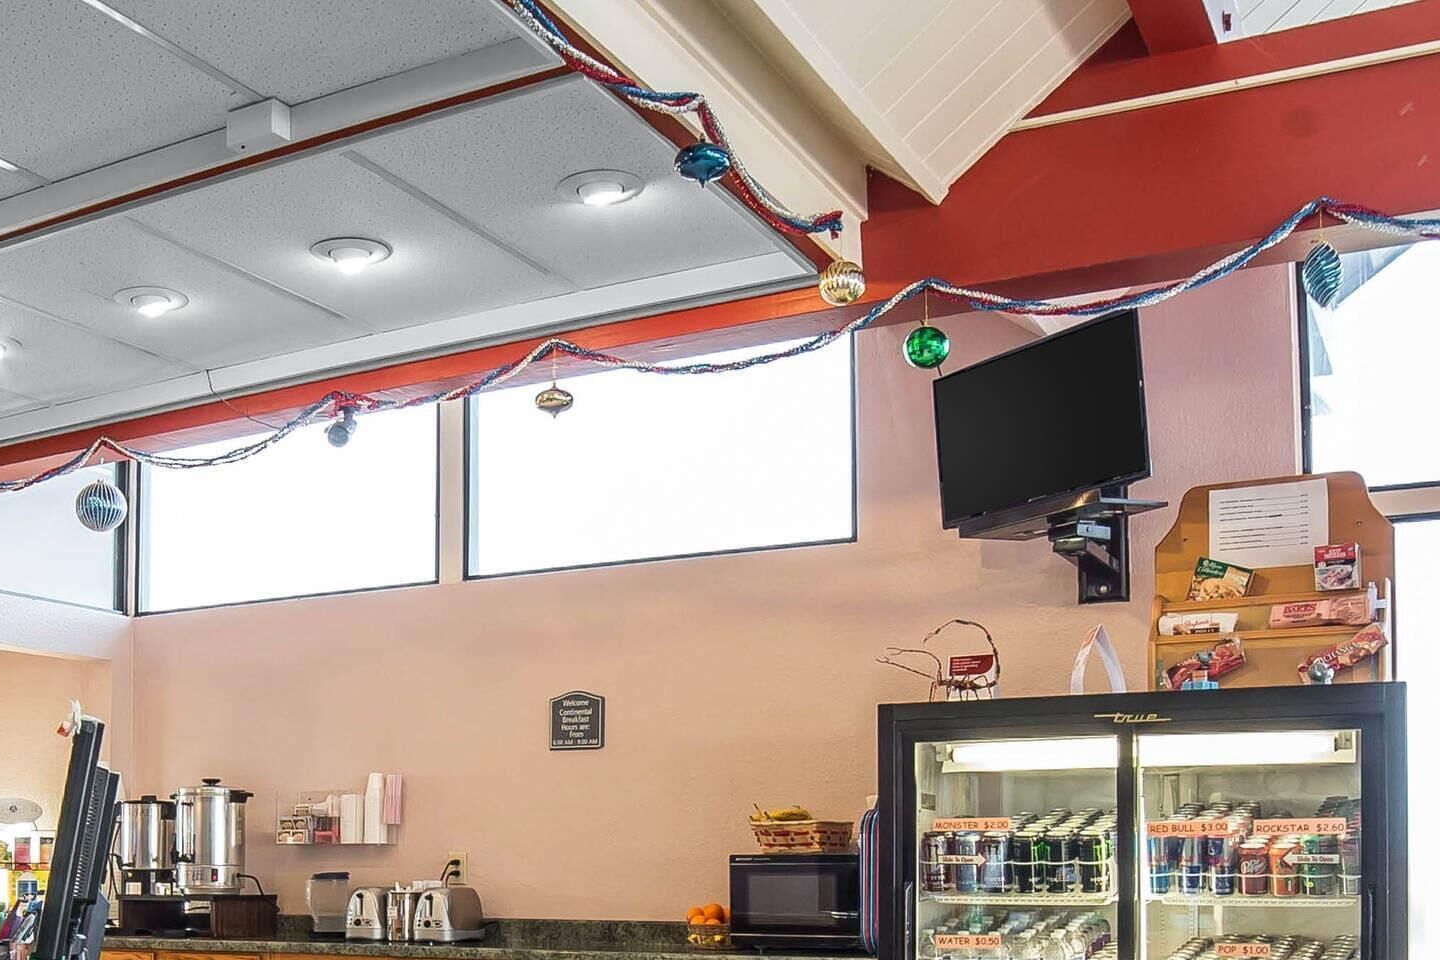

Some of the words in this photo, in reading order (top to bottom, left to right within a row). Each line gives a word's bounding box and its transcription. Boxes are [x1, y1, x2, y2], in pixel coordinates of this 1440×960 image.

[562, 699, 590, 707] Welcome
[559, 708, 592, 716] Continental
[934, 821, 979, 830] MONSTER
[984, 820, 1009, 830] $2.00
[1150, 823, 1169, 833] RED
[1171, 823, 1195, 832] BULL
[1200, 822, 1228, 832] $3.00
[1256, 823, 1310, 833] ROCKSTAR
[1316, 822, 1345, 832] $2.60
[938, 937, 970, 945] WATER
[975, 936, 1000, 946] $0.50
[1218, 945, 1237, 954] POP
[1243, 945, 1269, 955] $1.00
